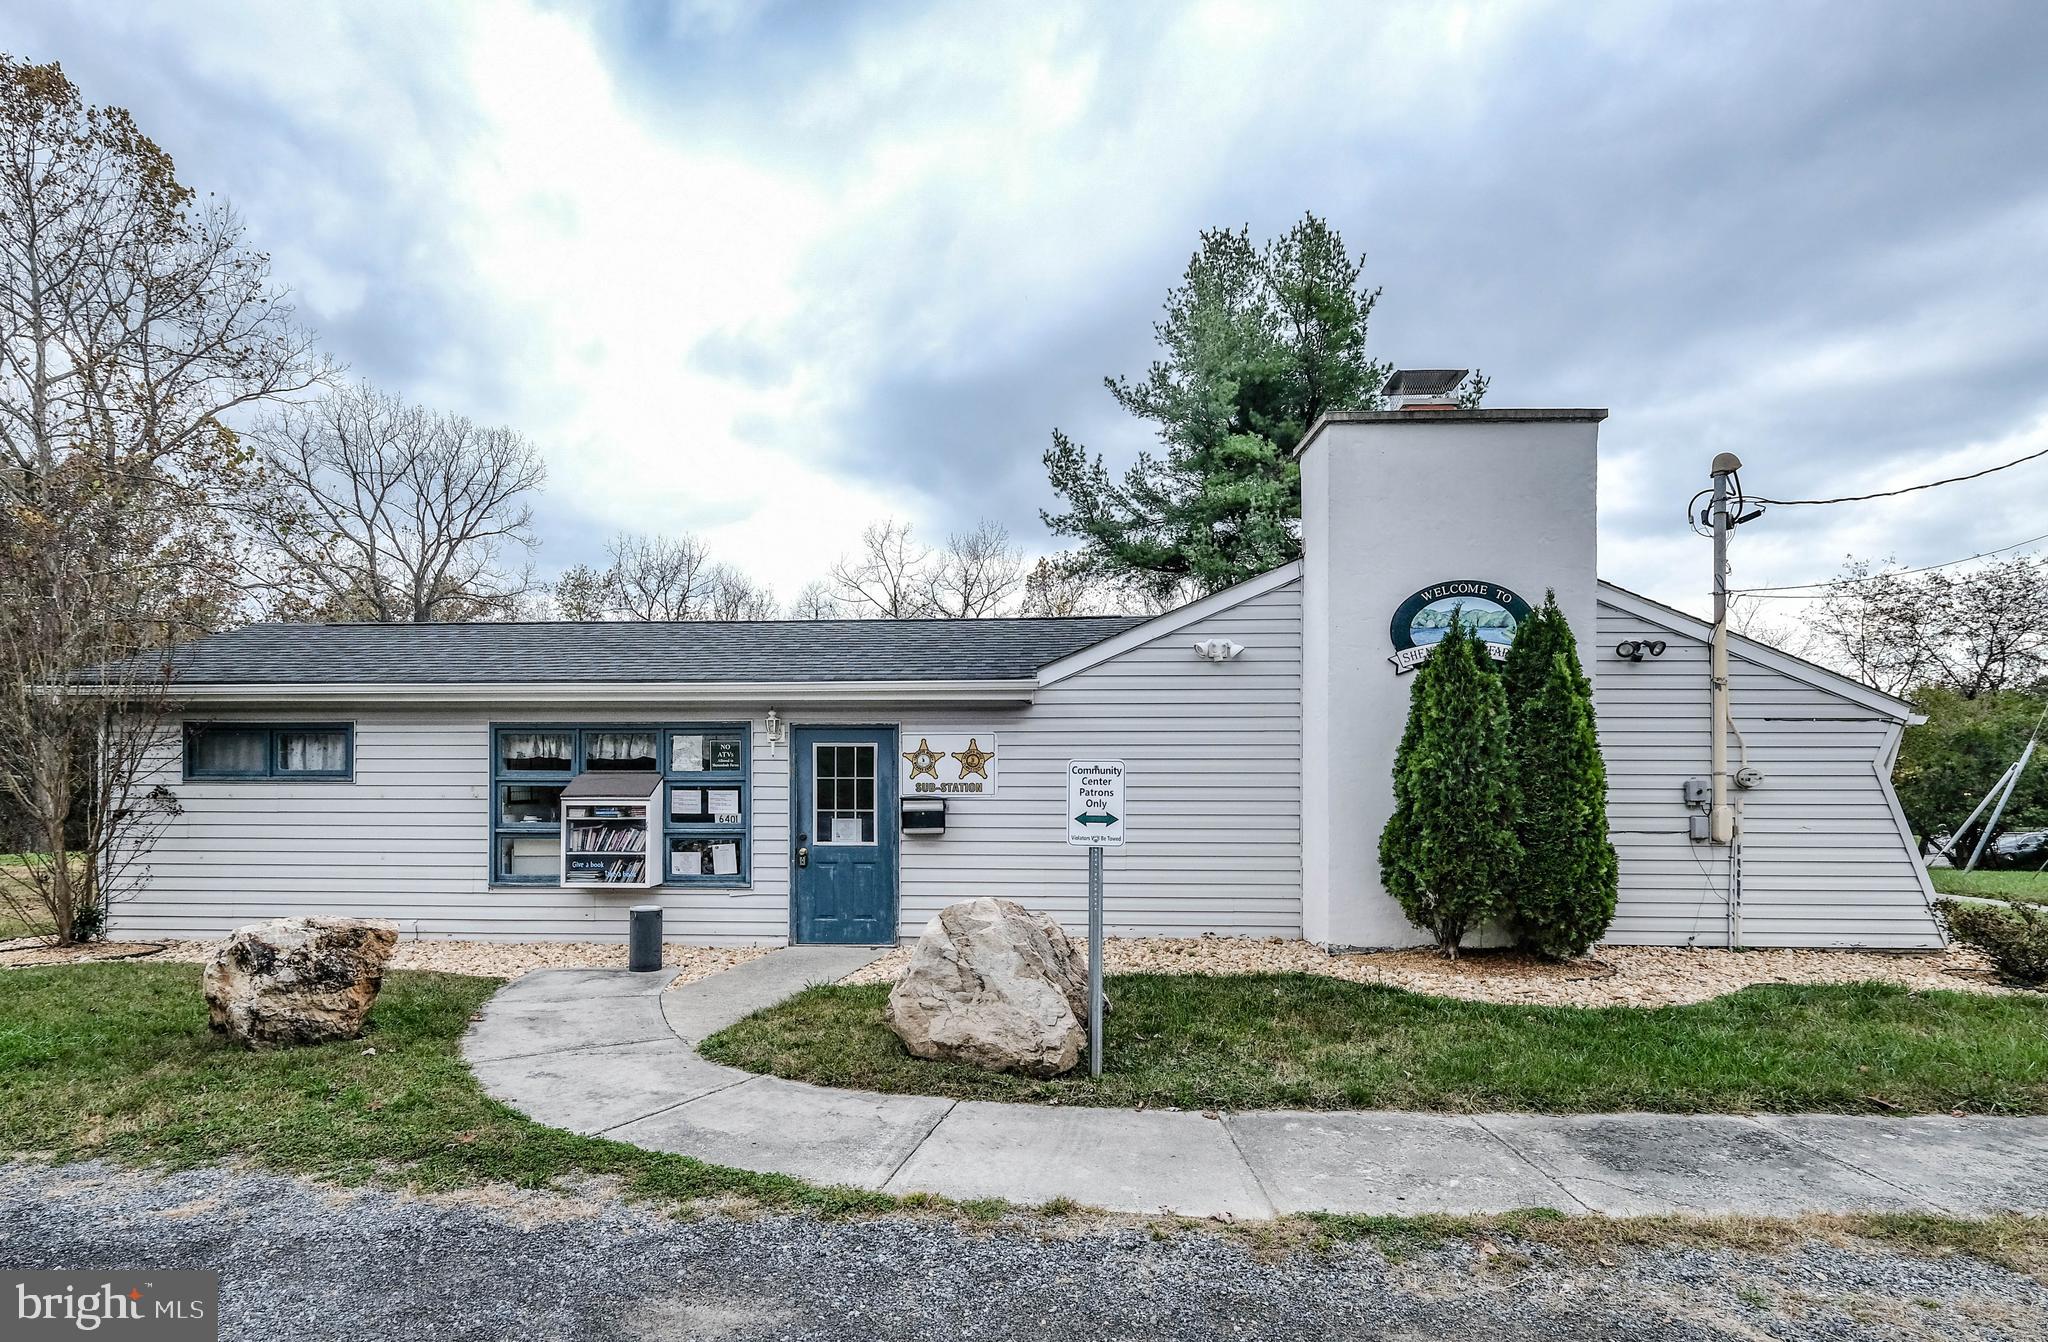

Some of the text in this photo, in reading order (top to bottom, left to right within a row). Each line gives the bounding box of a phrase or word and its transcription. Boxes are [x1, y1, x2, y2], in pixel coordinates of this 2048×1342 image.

[1420, 583, 1512, 604] WELCOME TO
[1402, 645, 1510, 663] SHEN FAR
[1071, 765, 1122, 777] Community
[1081, 777, 1112, 786] Center
[915, 782, 983, 793] SUB-STATION
[1079, 787, 1114, 797] Patrons
[1085, 798, 1107, 810] Only
[719, 815, 738, 823] 6401
